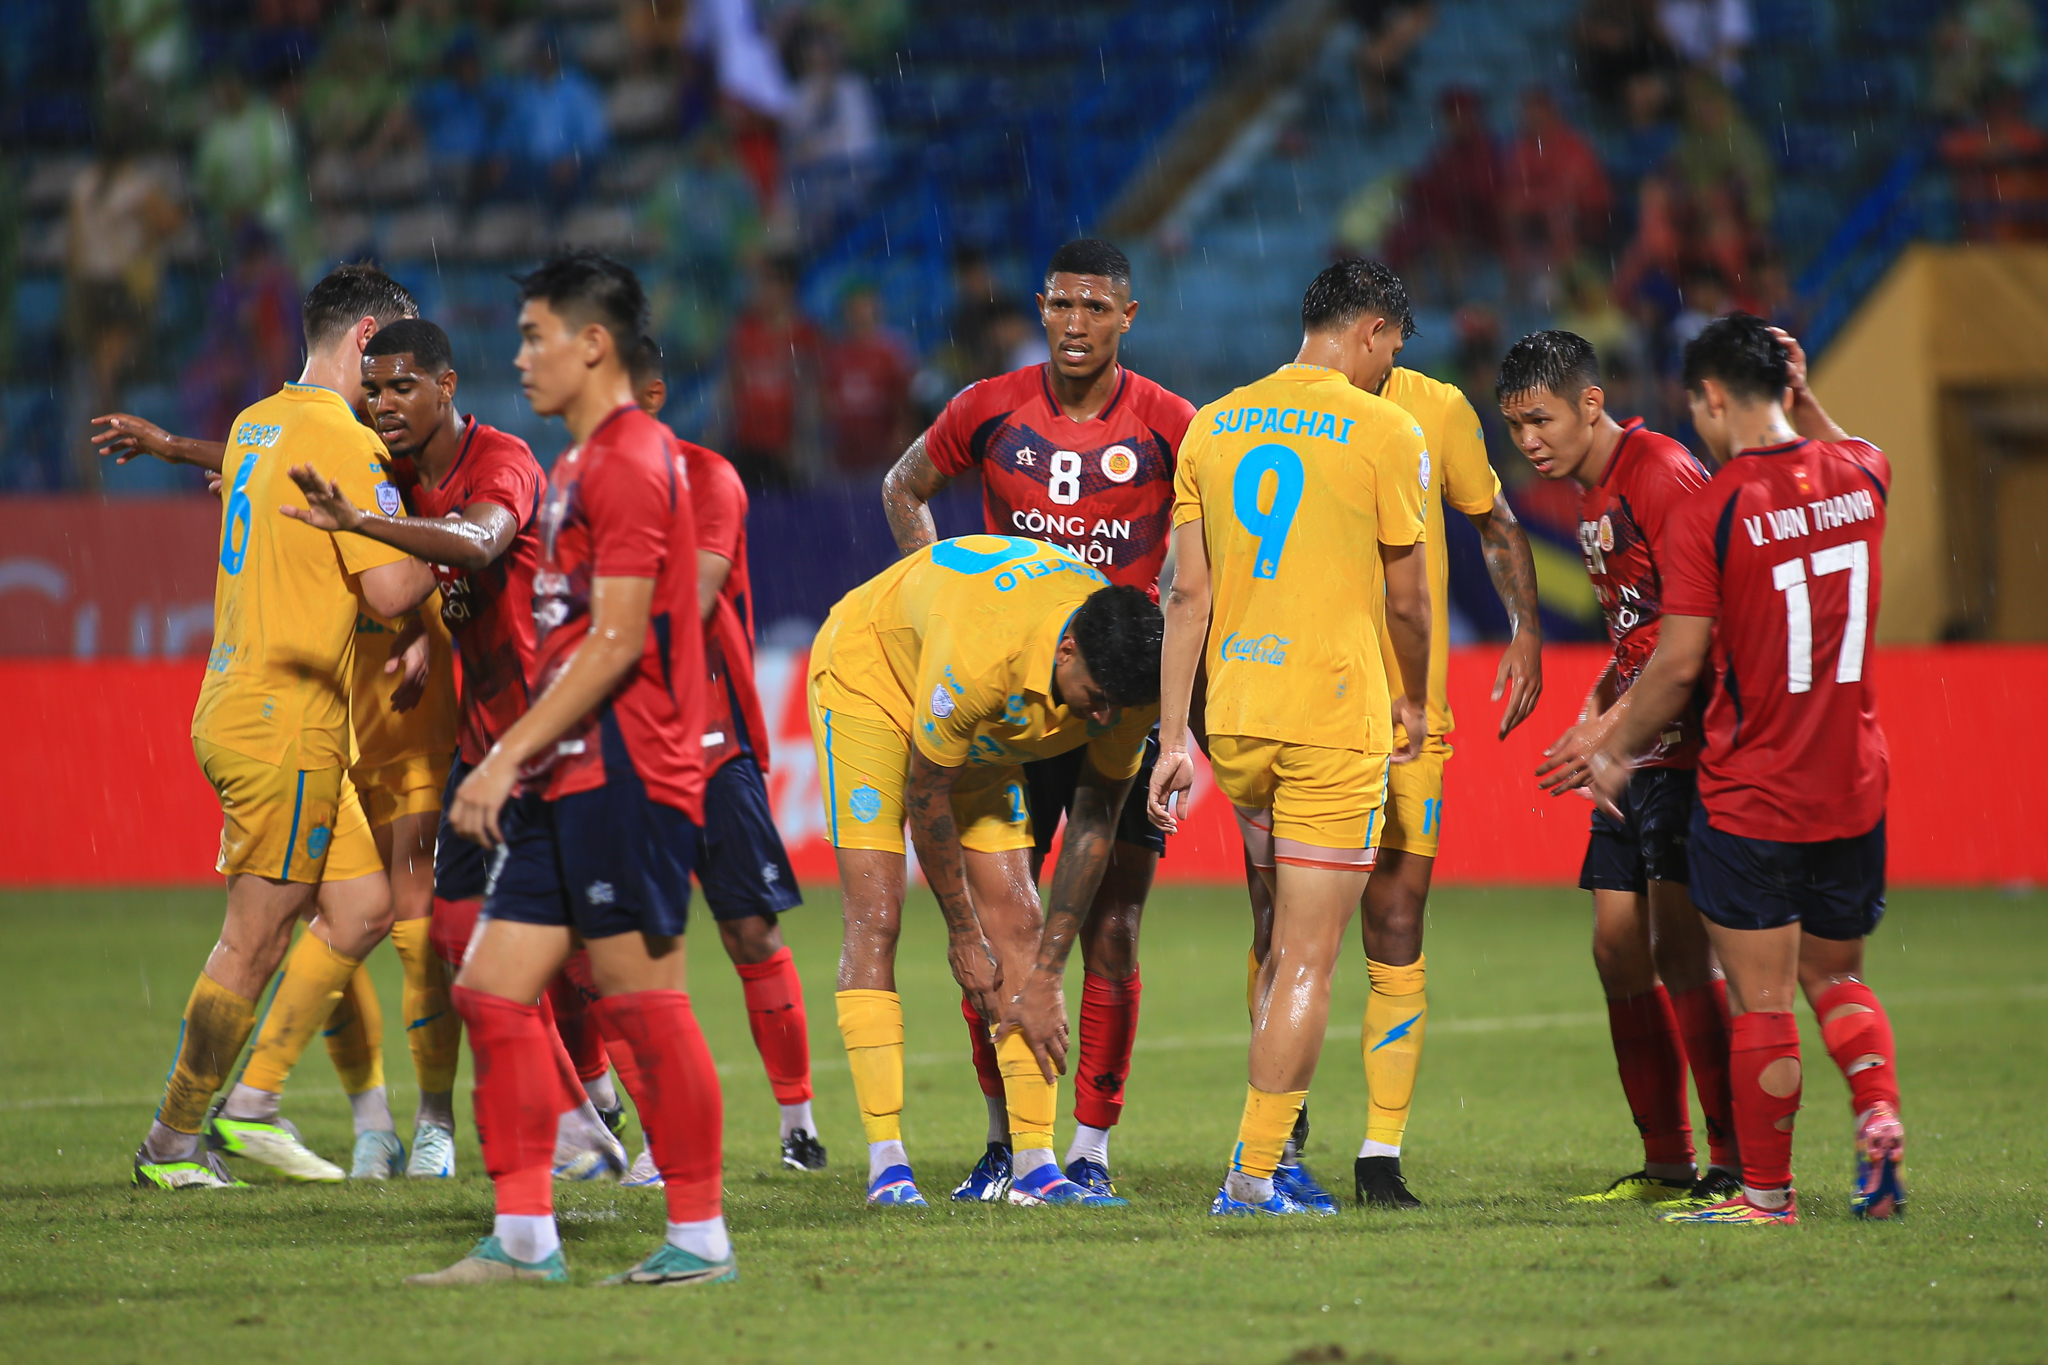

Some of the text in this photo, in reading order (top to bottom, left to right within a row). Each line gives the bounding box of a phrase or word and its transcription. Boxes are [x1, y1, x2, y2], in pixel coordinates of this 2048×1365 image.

[1211, 407, 1355, 444] SUPACHAI
[1048, 450, 1082, 505] 8
[220, 452, 260, 576] 6
[1012, 508, 1131, 540] CÔNG AN
[1233, 443, 1305, 580] 9
[1743, 488, 1876, 547] V. VAN THANH
[1067, 540, 1113, 567] NỘI
[1772, 540, 1869, 694] 17
